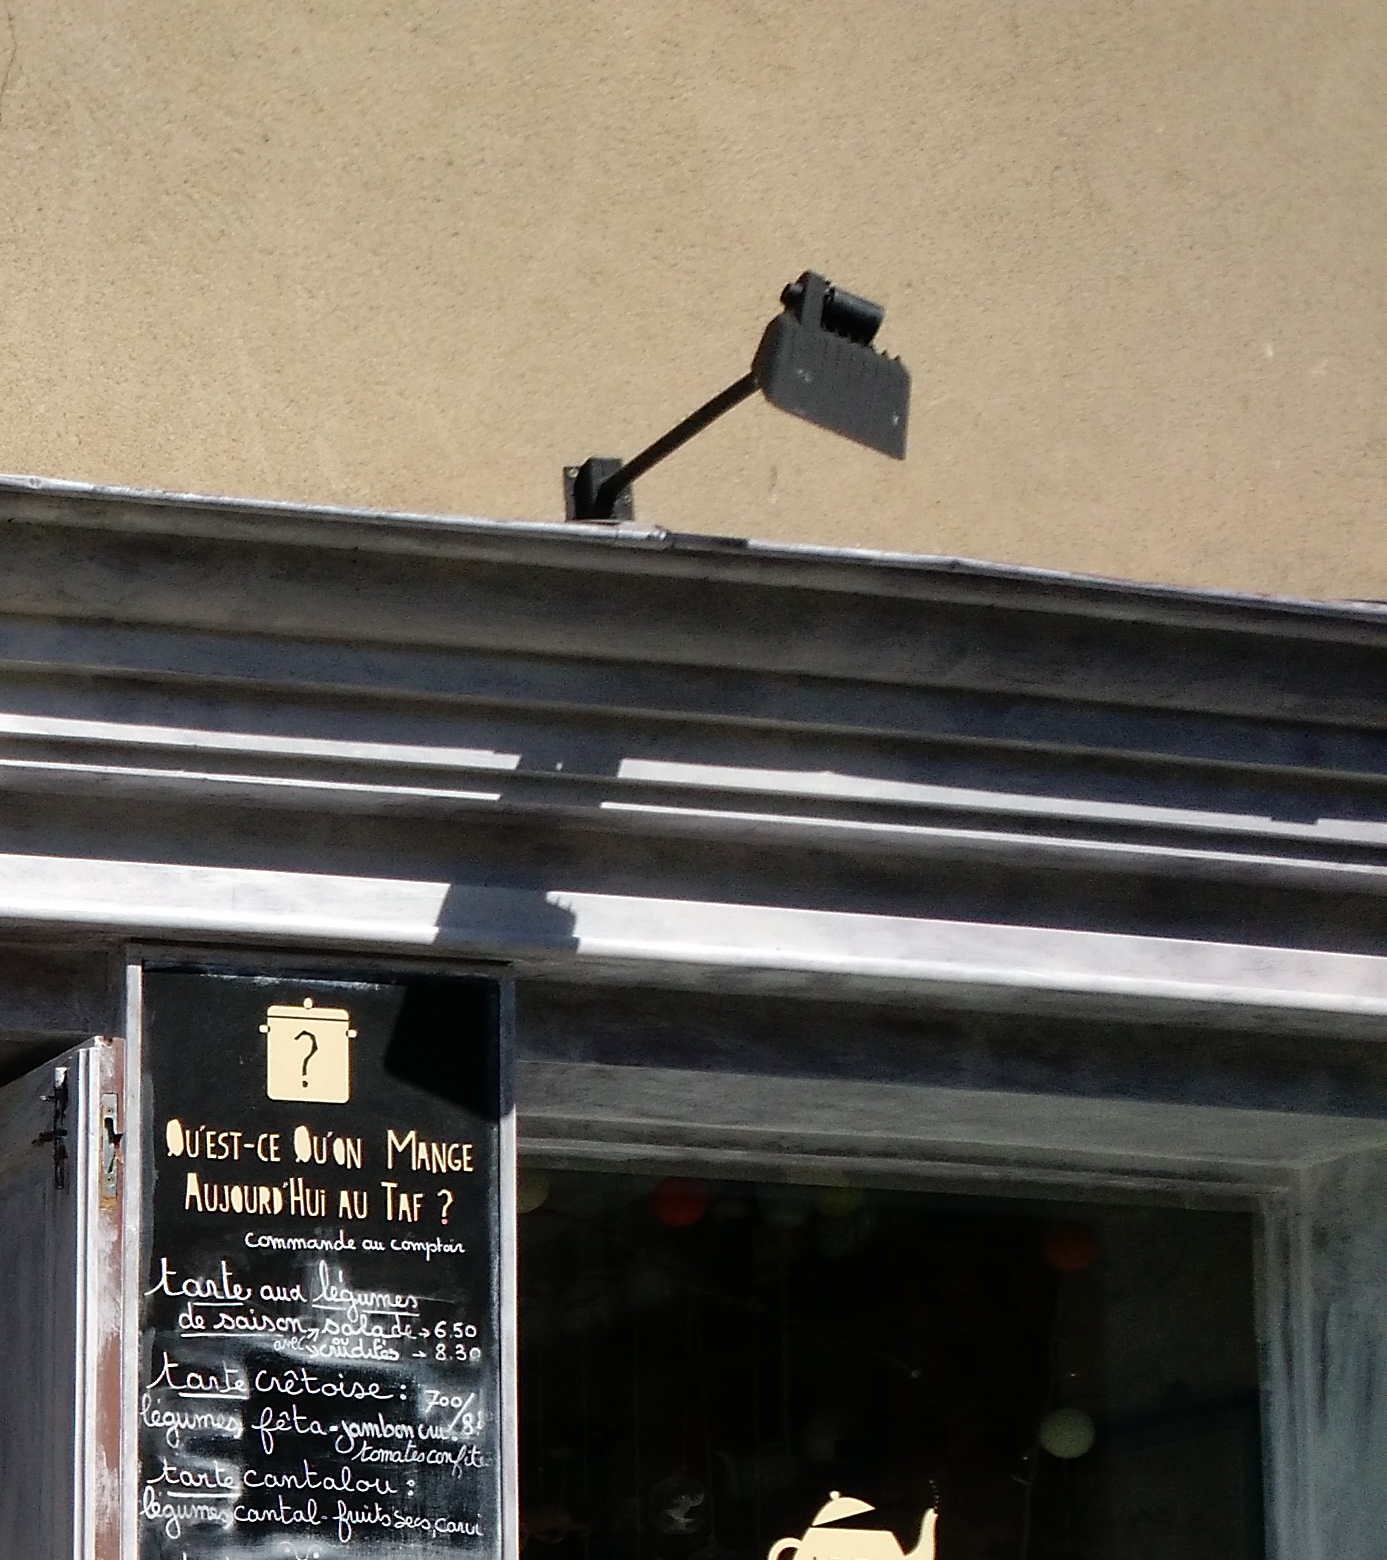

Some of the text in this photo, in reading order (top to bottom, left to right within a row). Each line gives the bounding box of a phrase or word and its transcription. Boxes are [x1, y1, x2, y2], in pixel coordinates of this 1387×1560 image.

[387, 1130, 473, 1173] MANGE
[339, 1190, 367, 1219] AU
[381, 1181, 424, 1222] TAF
[245, 1230, 465, 1261] commande au comptoir
[145, 1258, 252, 1297] tarte
[313, 1260, 419, 1322] légumes
[179, 1311, 206, 1329] de
[322, 1314, 417, 1338] salade
[434, 1321, 477, 1338] 6.50
[147, 1352, 247, 1392] tarte
[147, 1455, 398, 1495] tarte cantalou
[334, 1499, 391, 1542] fruits
